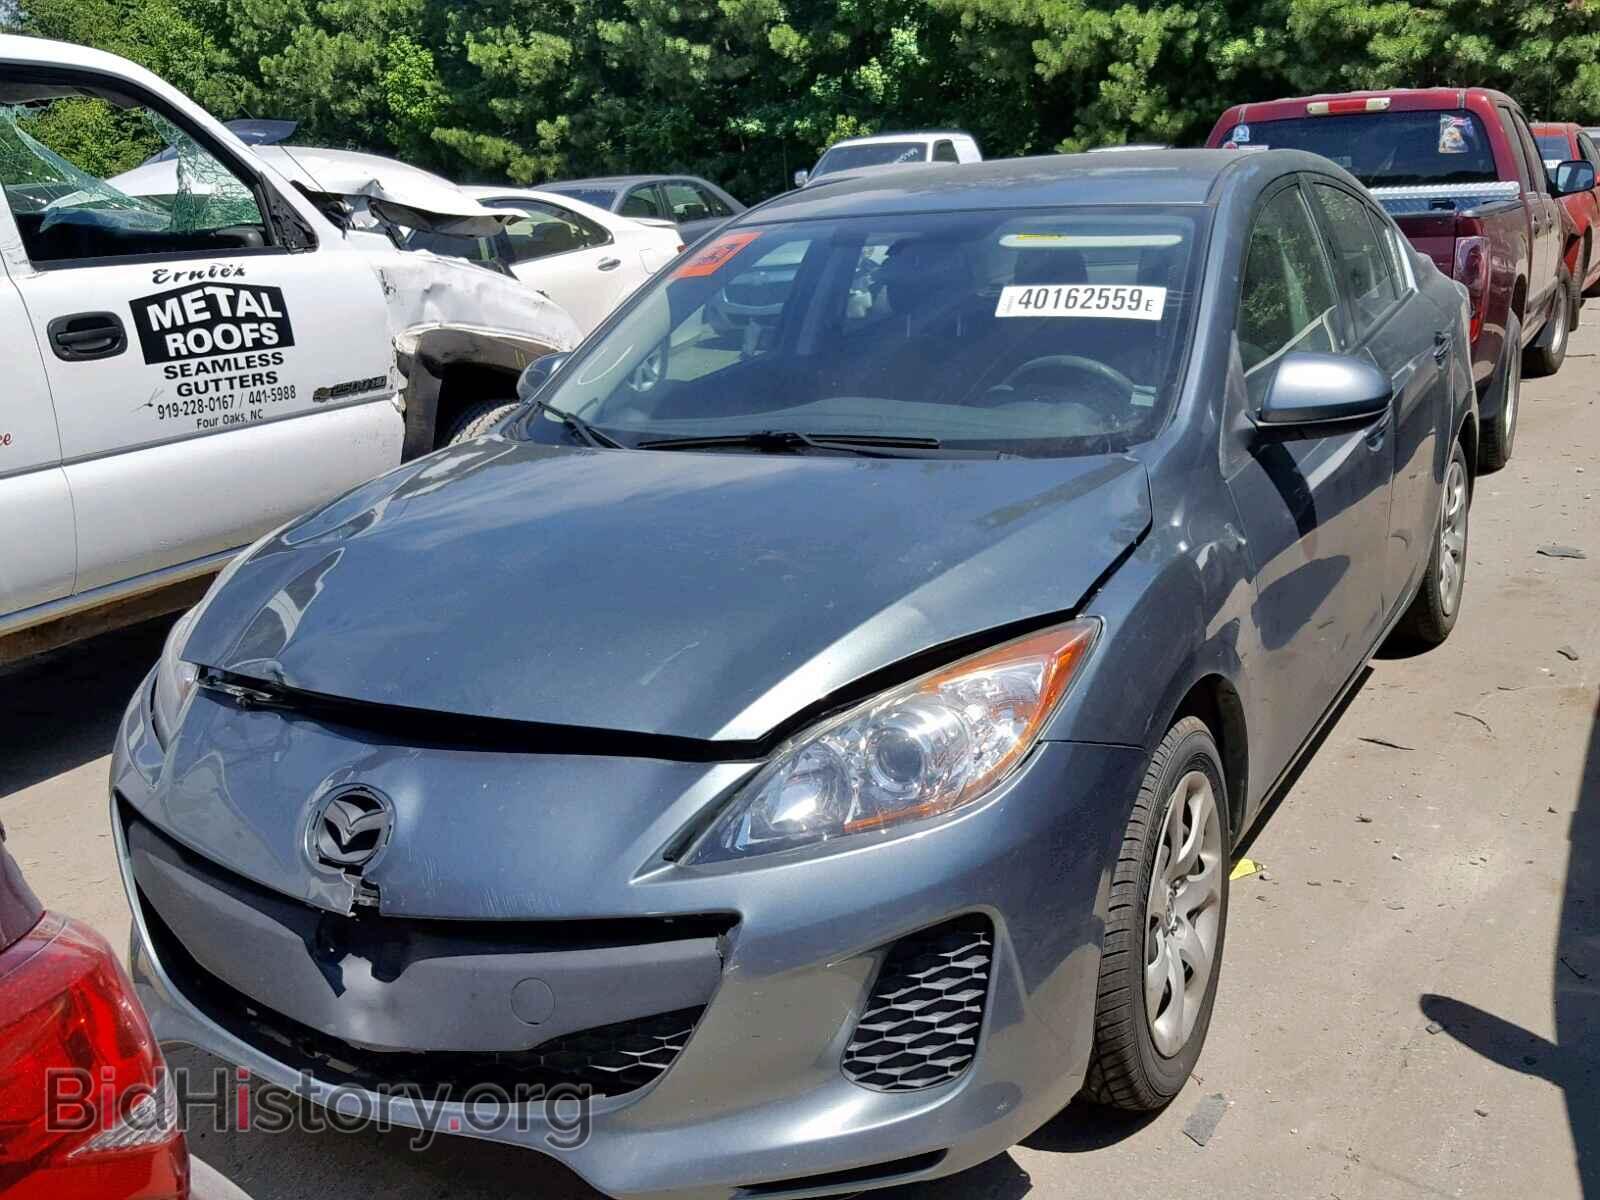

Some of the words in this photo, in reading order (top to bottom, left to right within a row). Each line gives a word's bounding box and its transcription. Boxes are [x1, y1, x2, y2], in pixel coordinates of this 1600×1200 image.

[146, 286, 283, 332] METAL
[1018, 287, 1143, 311] 40162559
[1145, 299, 1154, 312] E
[166, 322, 280, 357] ROOFS
[164, 352, 284, 380] SEAMLESS
[176, 371, 279, 397] GUTTERS
[157, 394, 235, 420] 919-228-0167
[248, 384, 297, 405] 441-5988
[196, 417, 219, 430] Four
[222, 411, 248, 425] Oaks,
[250, 408, 264, 420] NC
